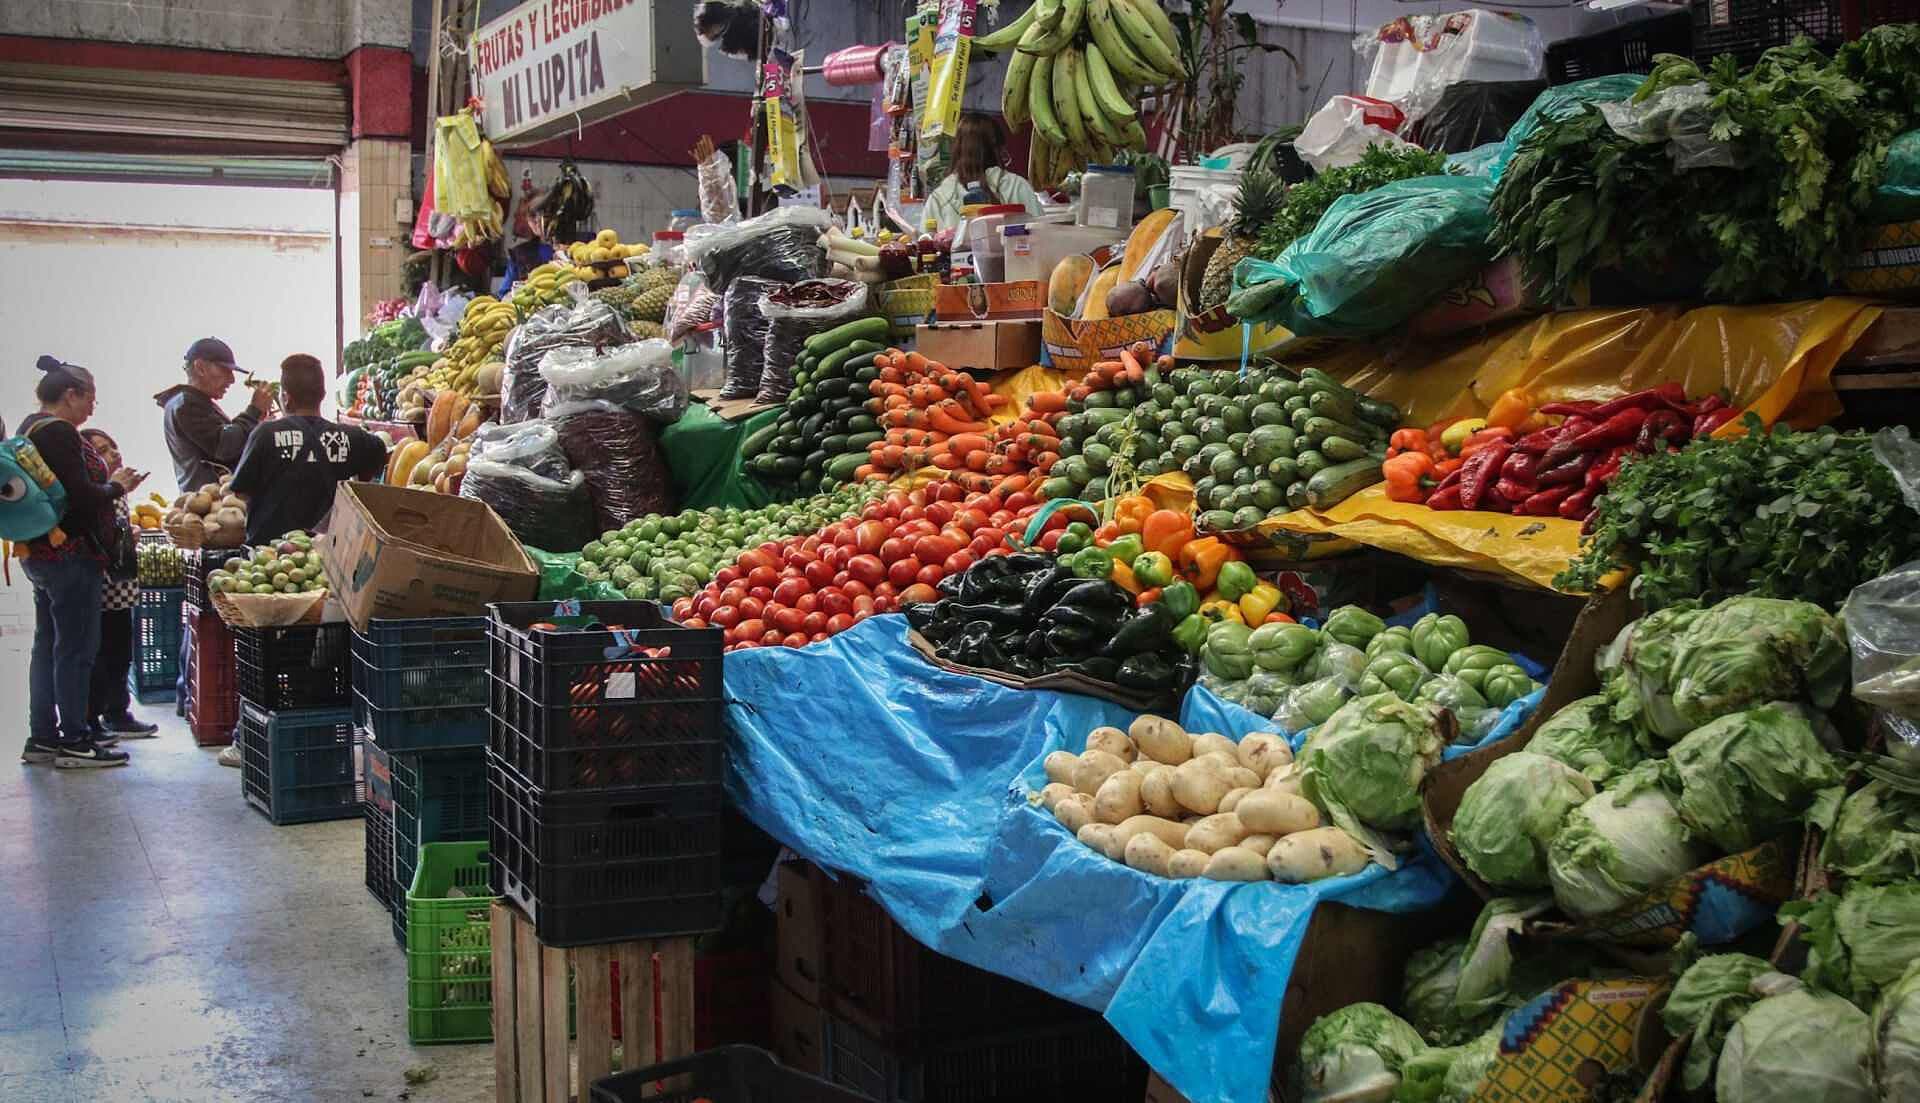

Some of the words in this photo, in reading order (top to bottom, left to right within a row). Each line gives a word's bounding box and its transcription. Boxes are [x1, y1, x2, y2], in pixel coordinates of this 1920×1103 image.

[477, 19, 523, 78] FRUTAS
[528, 10, 537, 51] Y
[502, 73, 522, 128] MI
[526, 31, 605, 118] LUPITA
